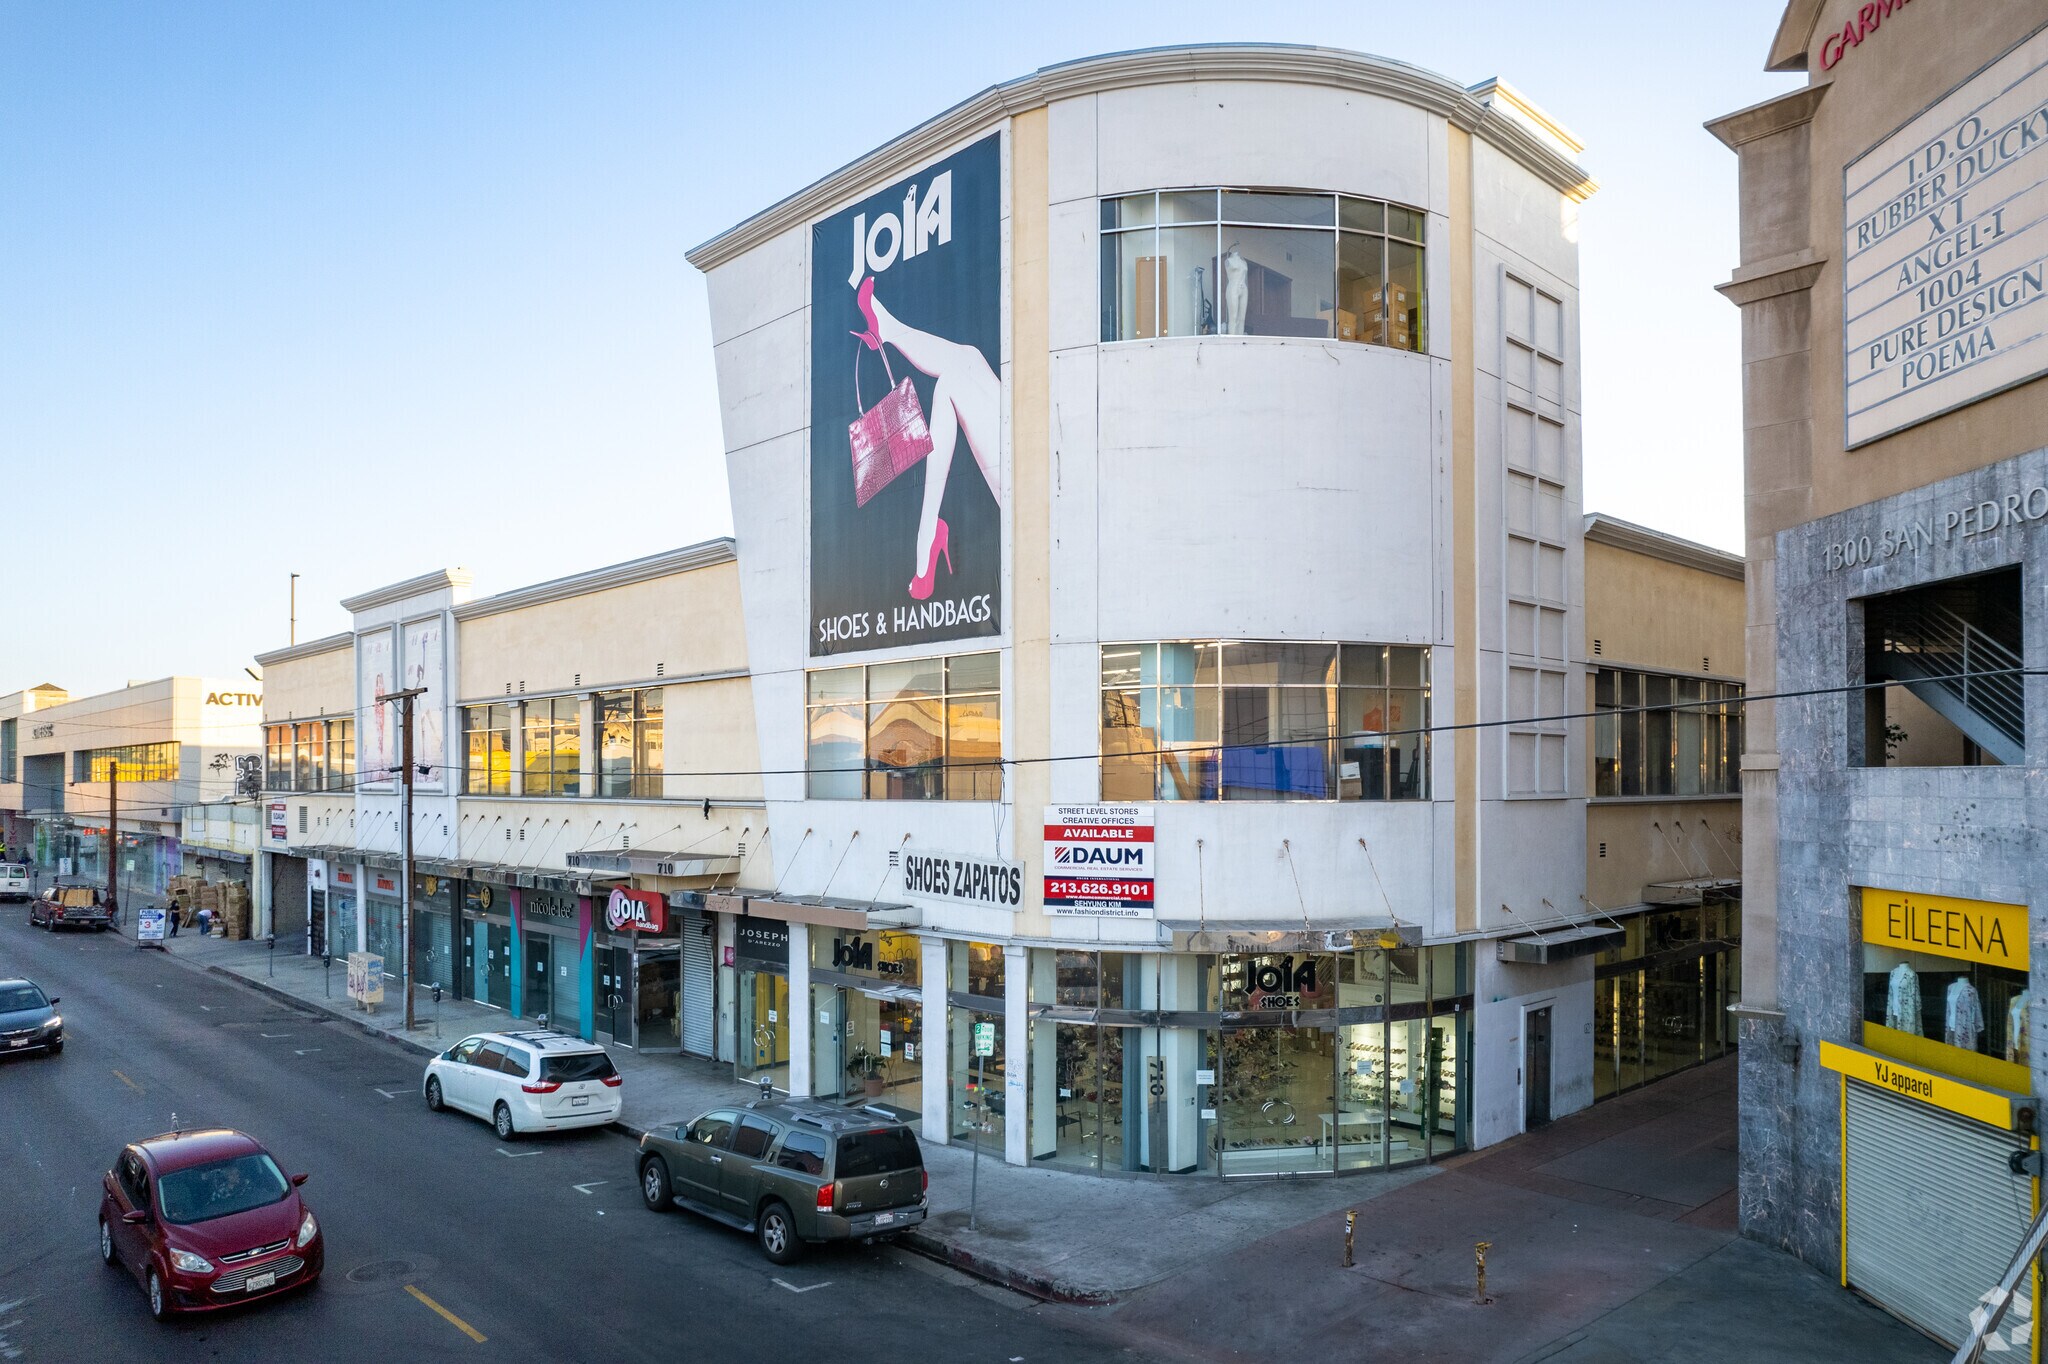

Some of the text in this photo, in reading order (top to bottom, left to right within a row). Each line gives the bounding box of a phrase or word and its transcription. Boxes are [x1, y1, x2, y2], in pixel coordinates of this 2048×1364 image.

[1857, 107, 2048, 249] RUBBER DUCKY
[1916, 259, 1982, 313] 1004
[1869, 263, 2043, 370] PURE DESIGN
[1902, 326, 1996, 388] POEMA
[1823, 486, 2048, 572] 1300 SAN PEDRO
[819, 594, 991, 643] SHOES & HANDBAGS
[1063, 829, 1134, 838] AVAILABLE
[567, 856, 580, 866] 710
[1073, 847, 1143, 865] DAUM
[657, 863, 673, 875] 710
[905, 855, 1021, 905] SHOES ZAPATOS
[1050, 882, 1148, 895] 213.626.9101
[530, 897, 556, 916] nicole
[613, 899, 646, 921] JOIA
[1056, 908, 1139, 917] www.fashiondistrict.info
[1074, 900, 1107, 908] SEHYUNG
[144, 920, 151, 929] 3
[740, 929, 788, 942] JOSEPH
[1259, 996, 1300, 1008] SHOES
[976, 1024, 982, 1034] 2
[1874, 1061, 1933, 1099] YJ apparel
